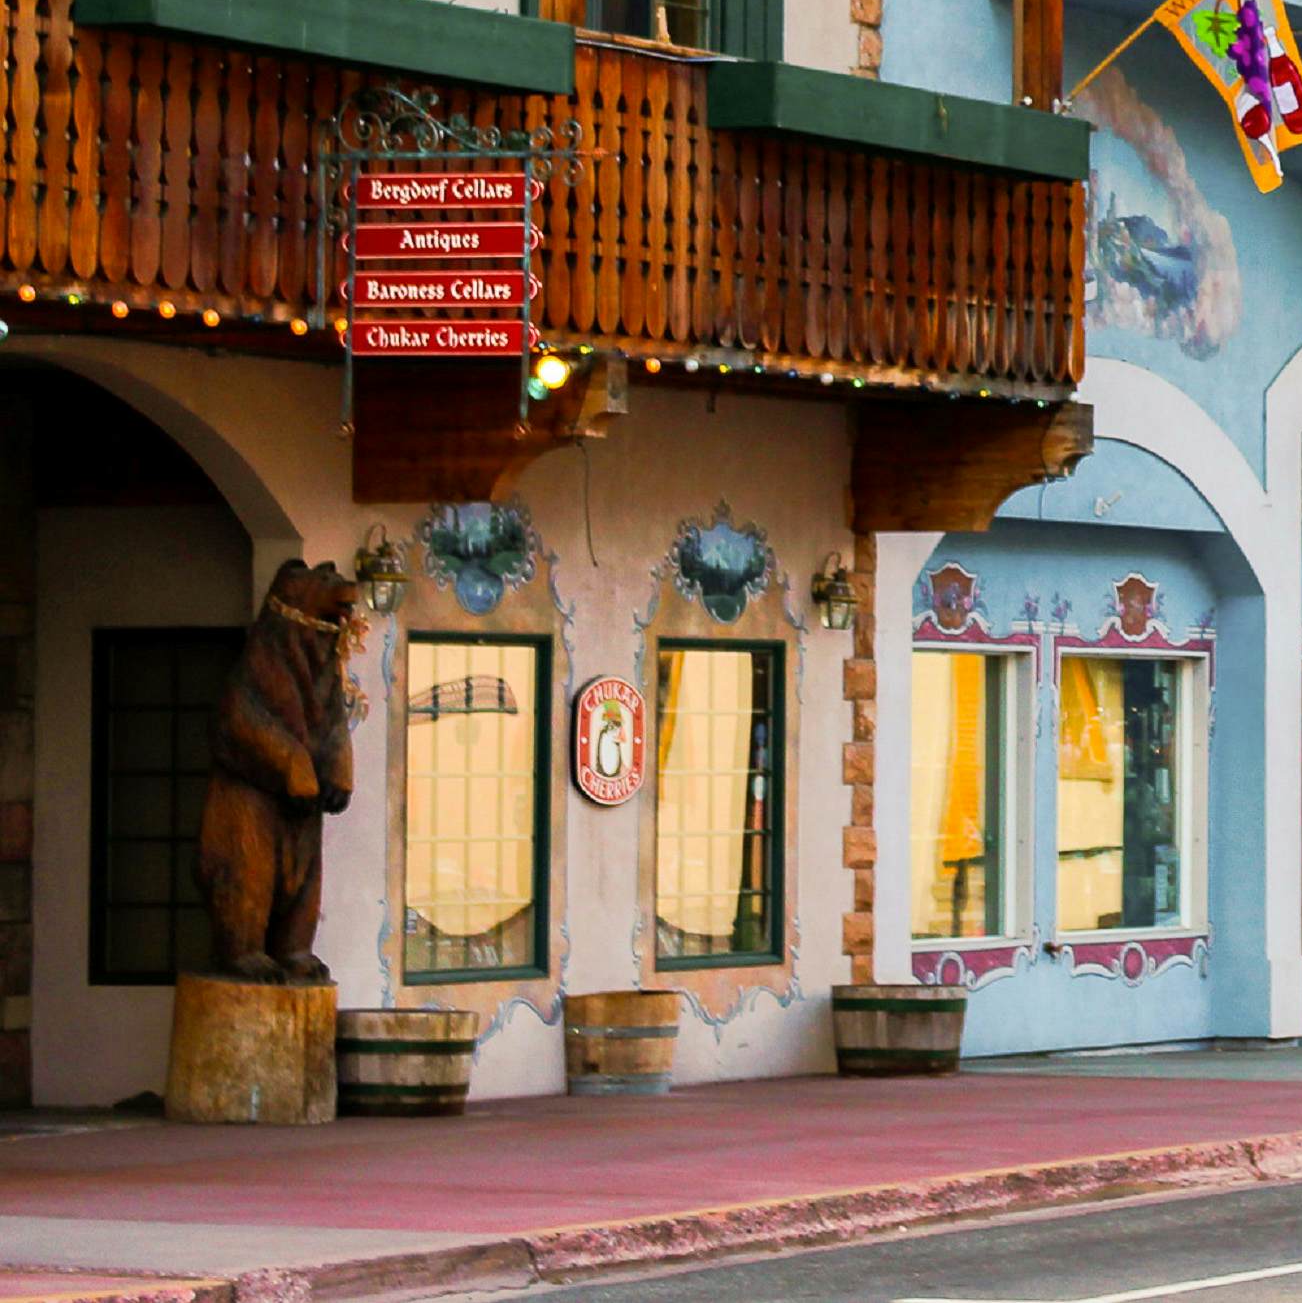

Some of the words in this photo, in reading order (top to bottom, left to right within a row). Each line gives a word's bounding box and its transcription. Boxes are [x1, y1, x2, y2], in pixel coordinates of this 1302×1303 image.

[371, 178, 449, 204] Bergdorf
[452, 178, 513, 199] Cellars
[399, 229, 480, 253] Antiques
[366, 279, 445, 300] Baroness
[450, 278, 512, 300] Cellars
[366, 326, 431, 348] Chukar
[435, 326, 509, 348] Cherries
[583, 680, 640, 713] CHUKAR
[581, 765, 640, 800] CHERRIES
